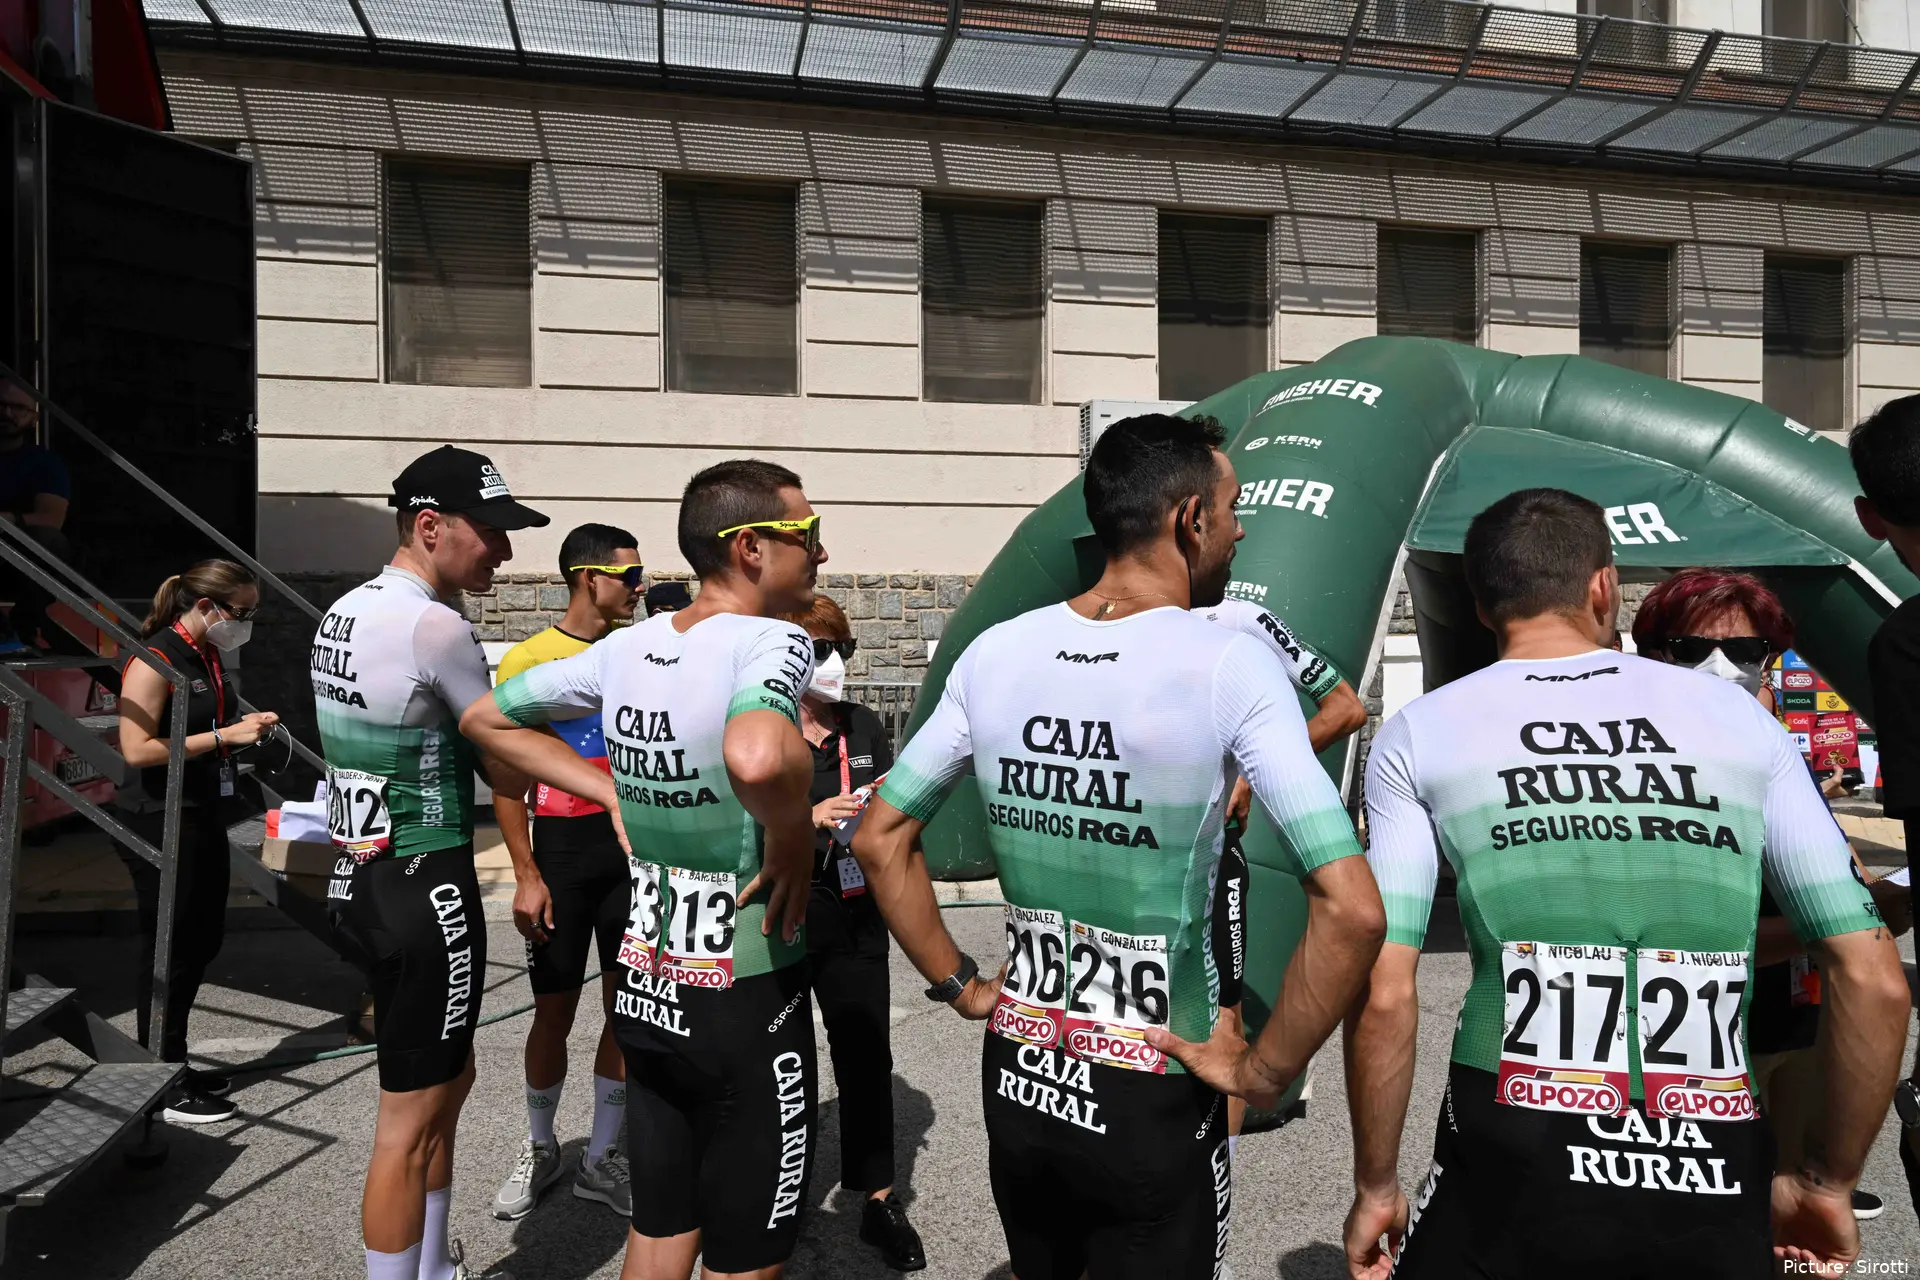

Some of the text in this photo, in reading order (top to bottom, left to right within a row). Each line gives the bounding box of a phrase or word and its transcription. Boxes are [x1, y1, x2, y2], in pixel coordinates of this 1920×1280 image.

[1263, 379, 1383, 409] FINISHER
[1275, 435, 1322, 446] KERN
[1236, 479, 1334, 517] SHER
[320, 612, 356, 643] CAJA
[1256, 612, 1301, 663] RGA
[310, 644, 357, 683] RURAL
[1056, 650, 1119, 664] MMR
[1524, 666, 1622, 682] MMR
[615, 705, 676, 744] CAJA
[1022, 715, 1120, 761] CAJA
[1519, 717, 1677, 758] CAJA
[605, 737, 699, 782] RURAL
[653, 787, 720, 809] RGA
[998, 757, 1142, 814] RURAL
[1497, 763, 1720, 812] RURAL
[989, 802, 1160, 850] SEGUROS RGA
[1490, 814, 1742, 856] SEGUROS RGA
[1101, 931, 1158, 951] GONZÁLEZ
[1227, 877, 1243, 980] SEGUROS RGA
[429, 883, 472, 1040] CAJA RURAL
[1004, 922, 1065, 1003] 216
[1548, 945, 1612, 961] NICOLAU
[627, 969, 679, 1003] CAJA
[1070, 943, 1169, 1025] 216
[615, 990, 690, 1037] RURAL
[768, 992, 803, 1033] GSPORT
[1503, 967, 1625, 1063] 217
[1017, 1044, 1094, 1094] CAJA
[997, 1068, 1107, 1134] RURAL
[767, 1051, 807, 1229] CAJA RURAL
[1586, 1109, 1712, 1148] CAJA
[1566, 1145, 1742, 1195] RURAL
